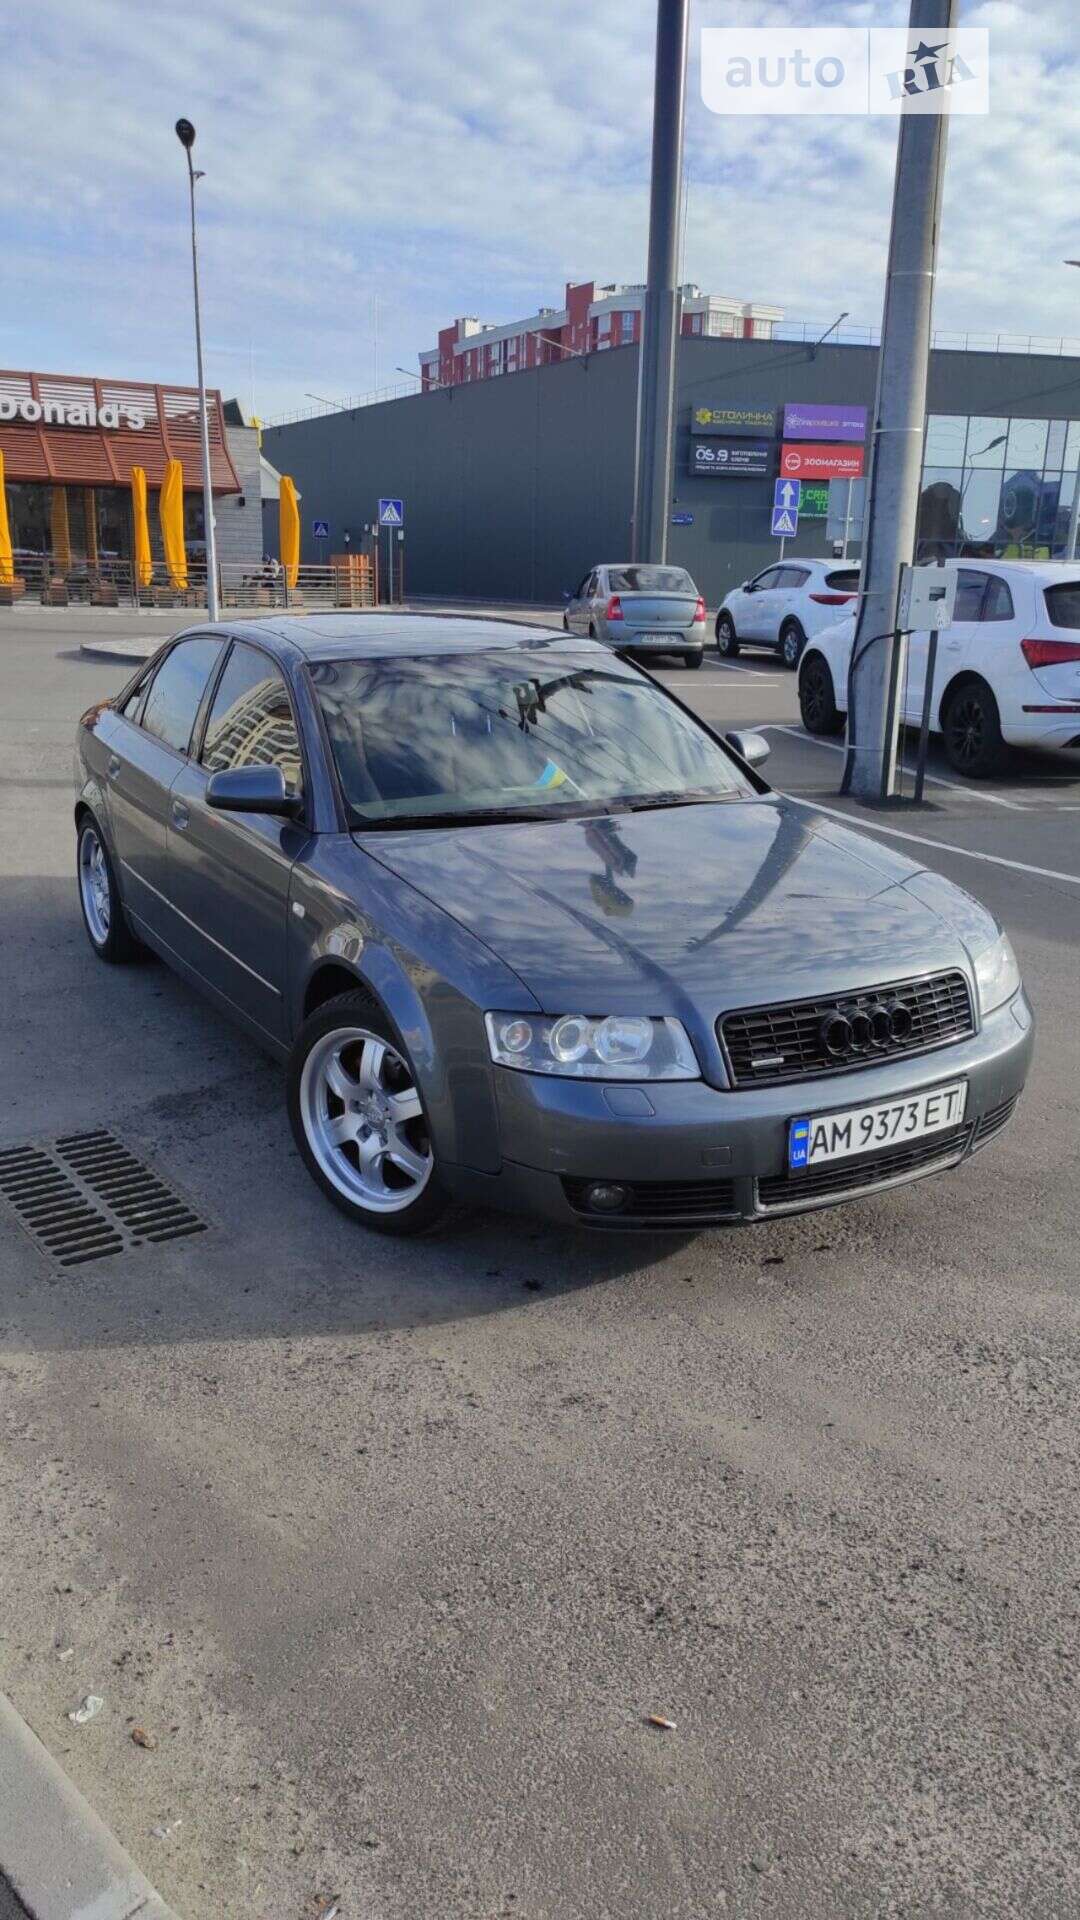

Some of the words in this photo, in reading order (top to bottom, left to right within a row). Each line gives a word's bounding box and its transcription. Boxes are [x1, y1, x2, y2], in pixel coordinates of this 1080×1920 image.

[806, 489, 828, 500] CRA
[810, 1119, 852, 1157] AM
[859, 1102, 920, 1146] 9373
[923, 1090, 960, 1127] ET
[792, 1151, 807, 1161] UA
